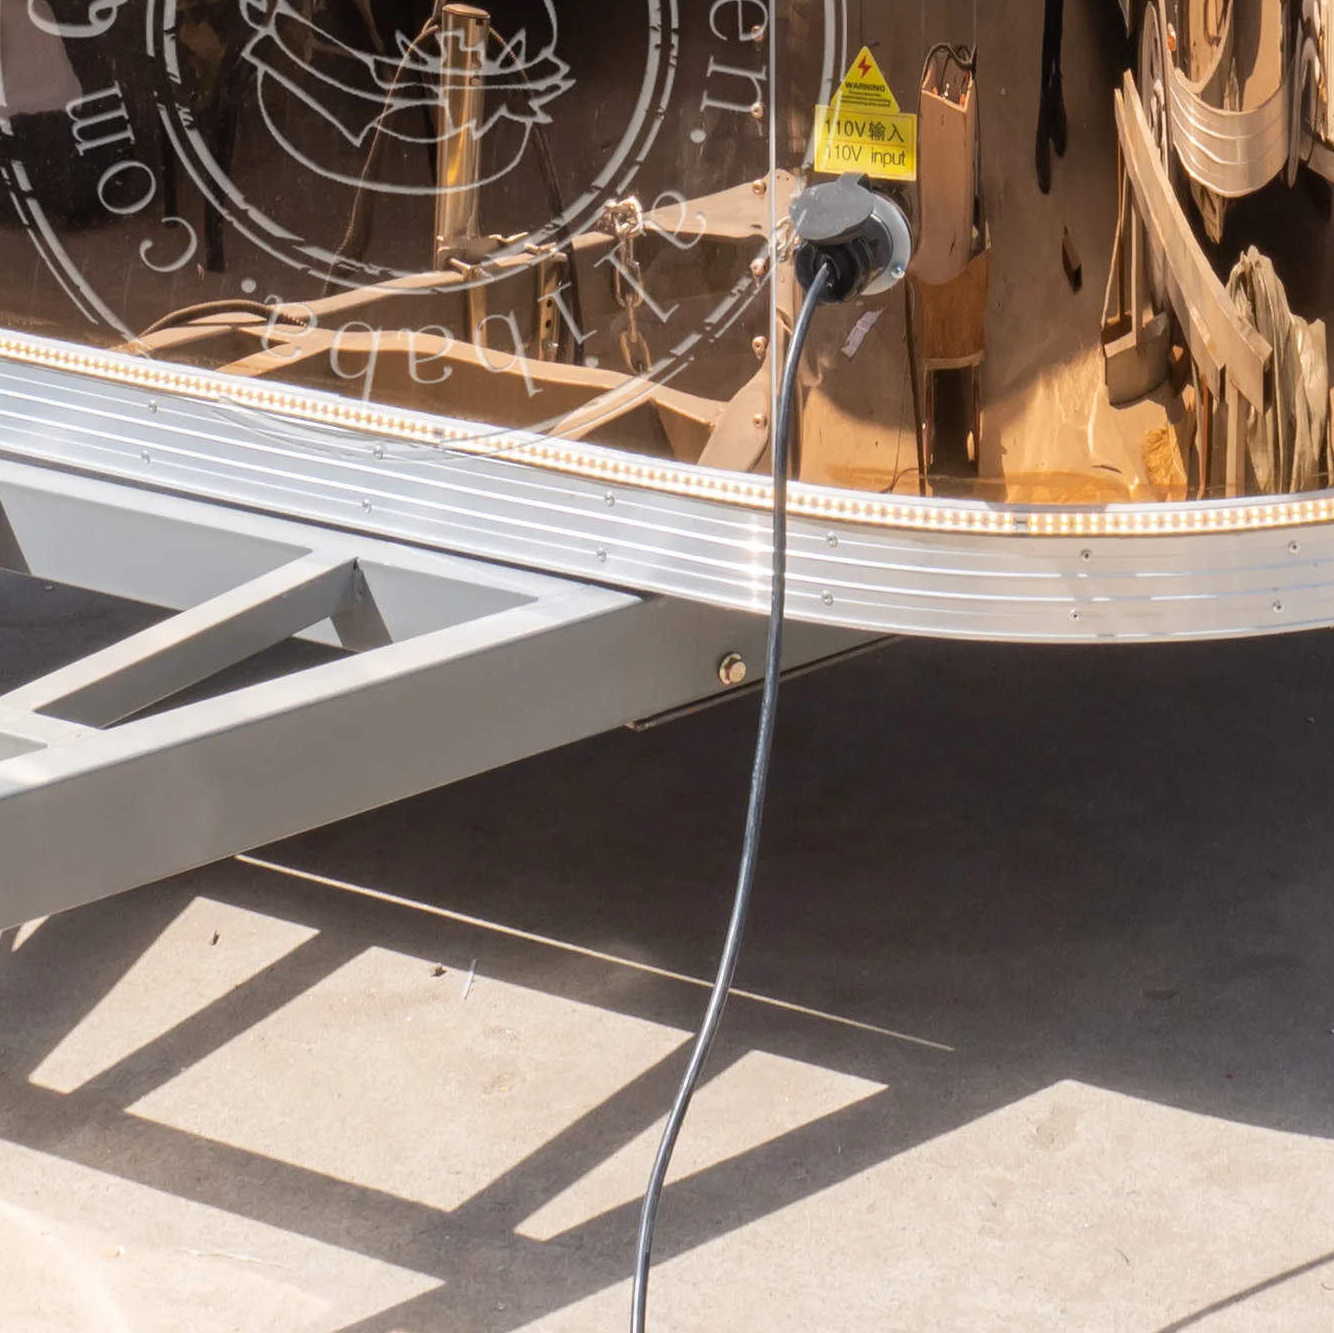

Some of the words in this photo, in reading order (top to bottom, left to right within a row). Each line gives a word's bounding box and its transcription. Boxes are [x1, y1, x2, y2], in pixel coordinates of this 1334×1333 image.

[845, 81, 886, 92] WARNING
[825, 144, 862, 162] 110V
[871, 147, 907, 168] input
